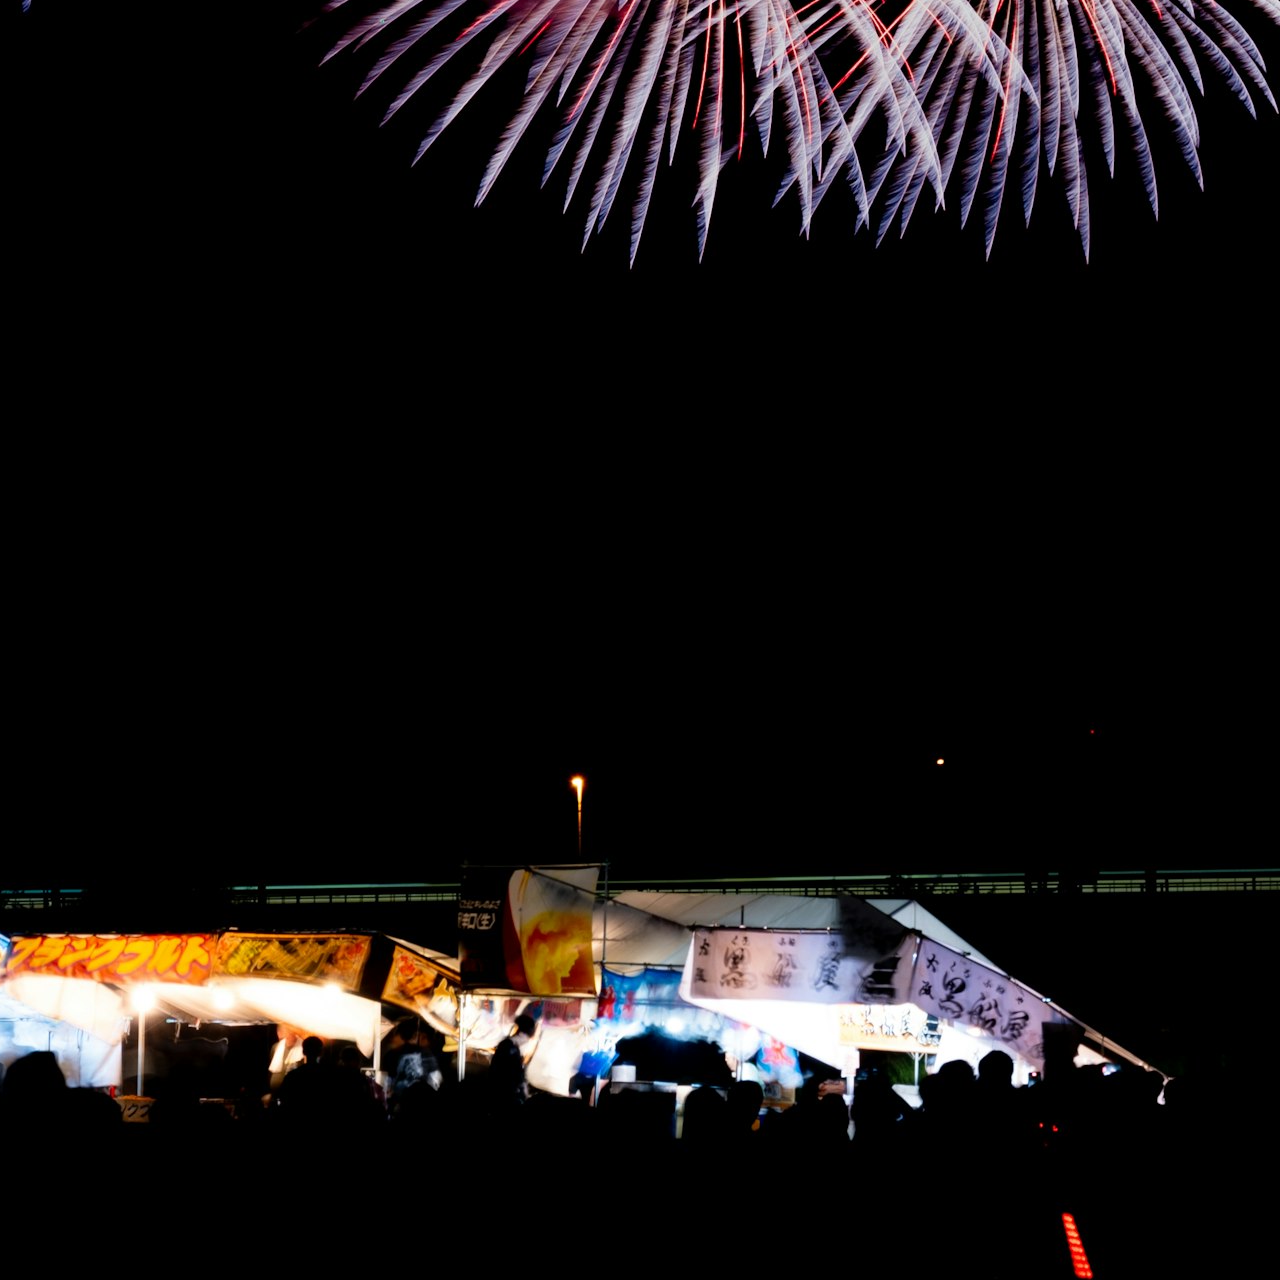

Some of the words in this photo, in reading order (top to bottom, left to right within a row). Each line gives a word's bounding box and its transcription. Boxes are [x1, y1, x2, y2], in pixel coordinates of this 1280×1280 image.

[6, 935, 210, 977] フランクフルト
